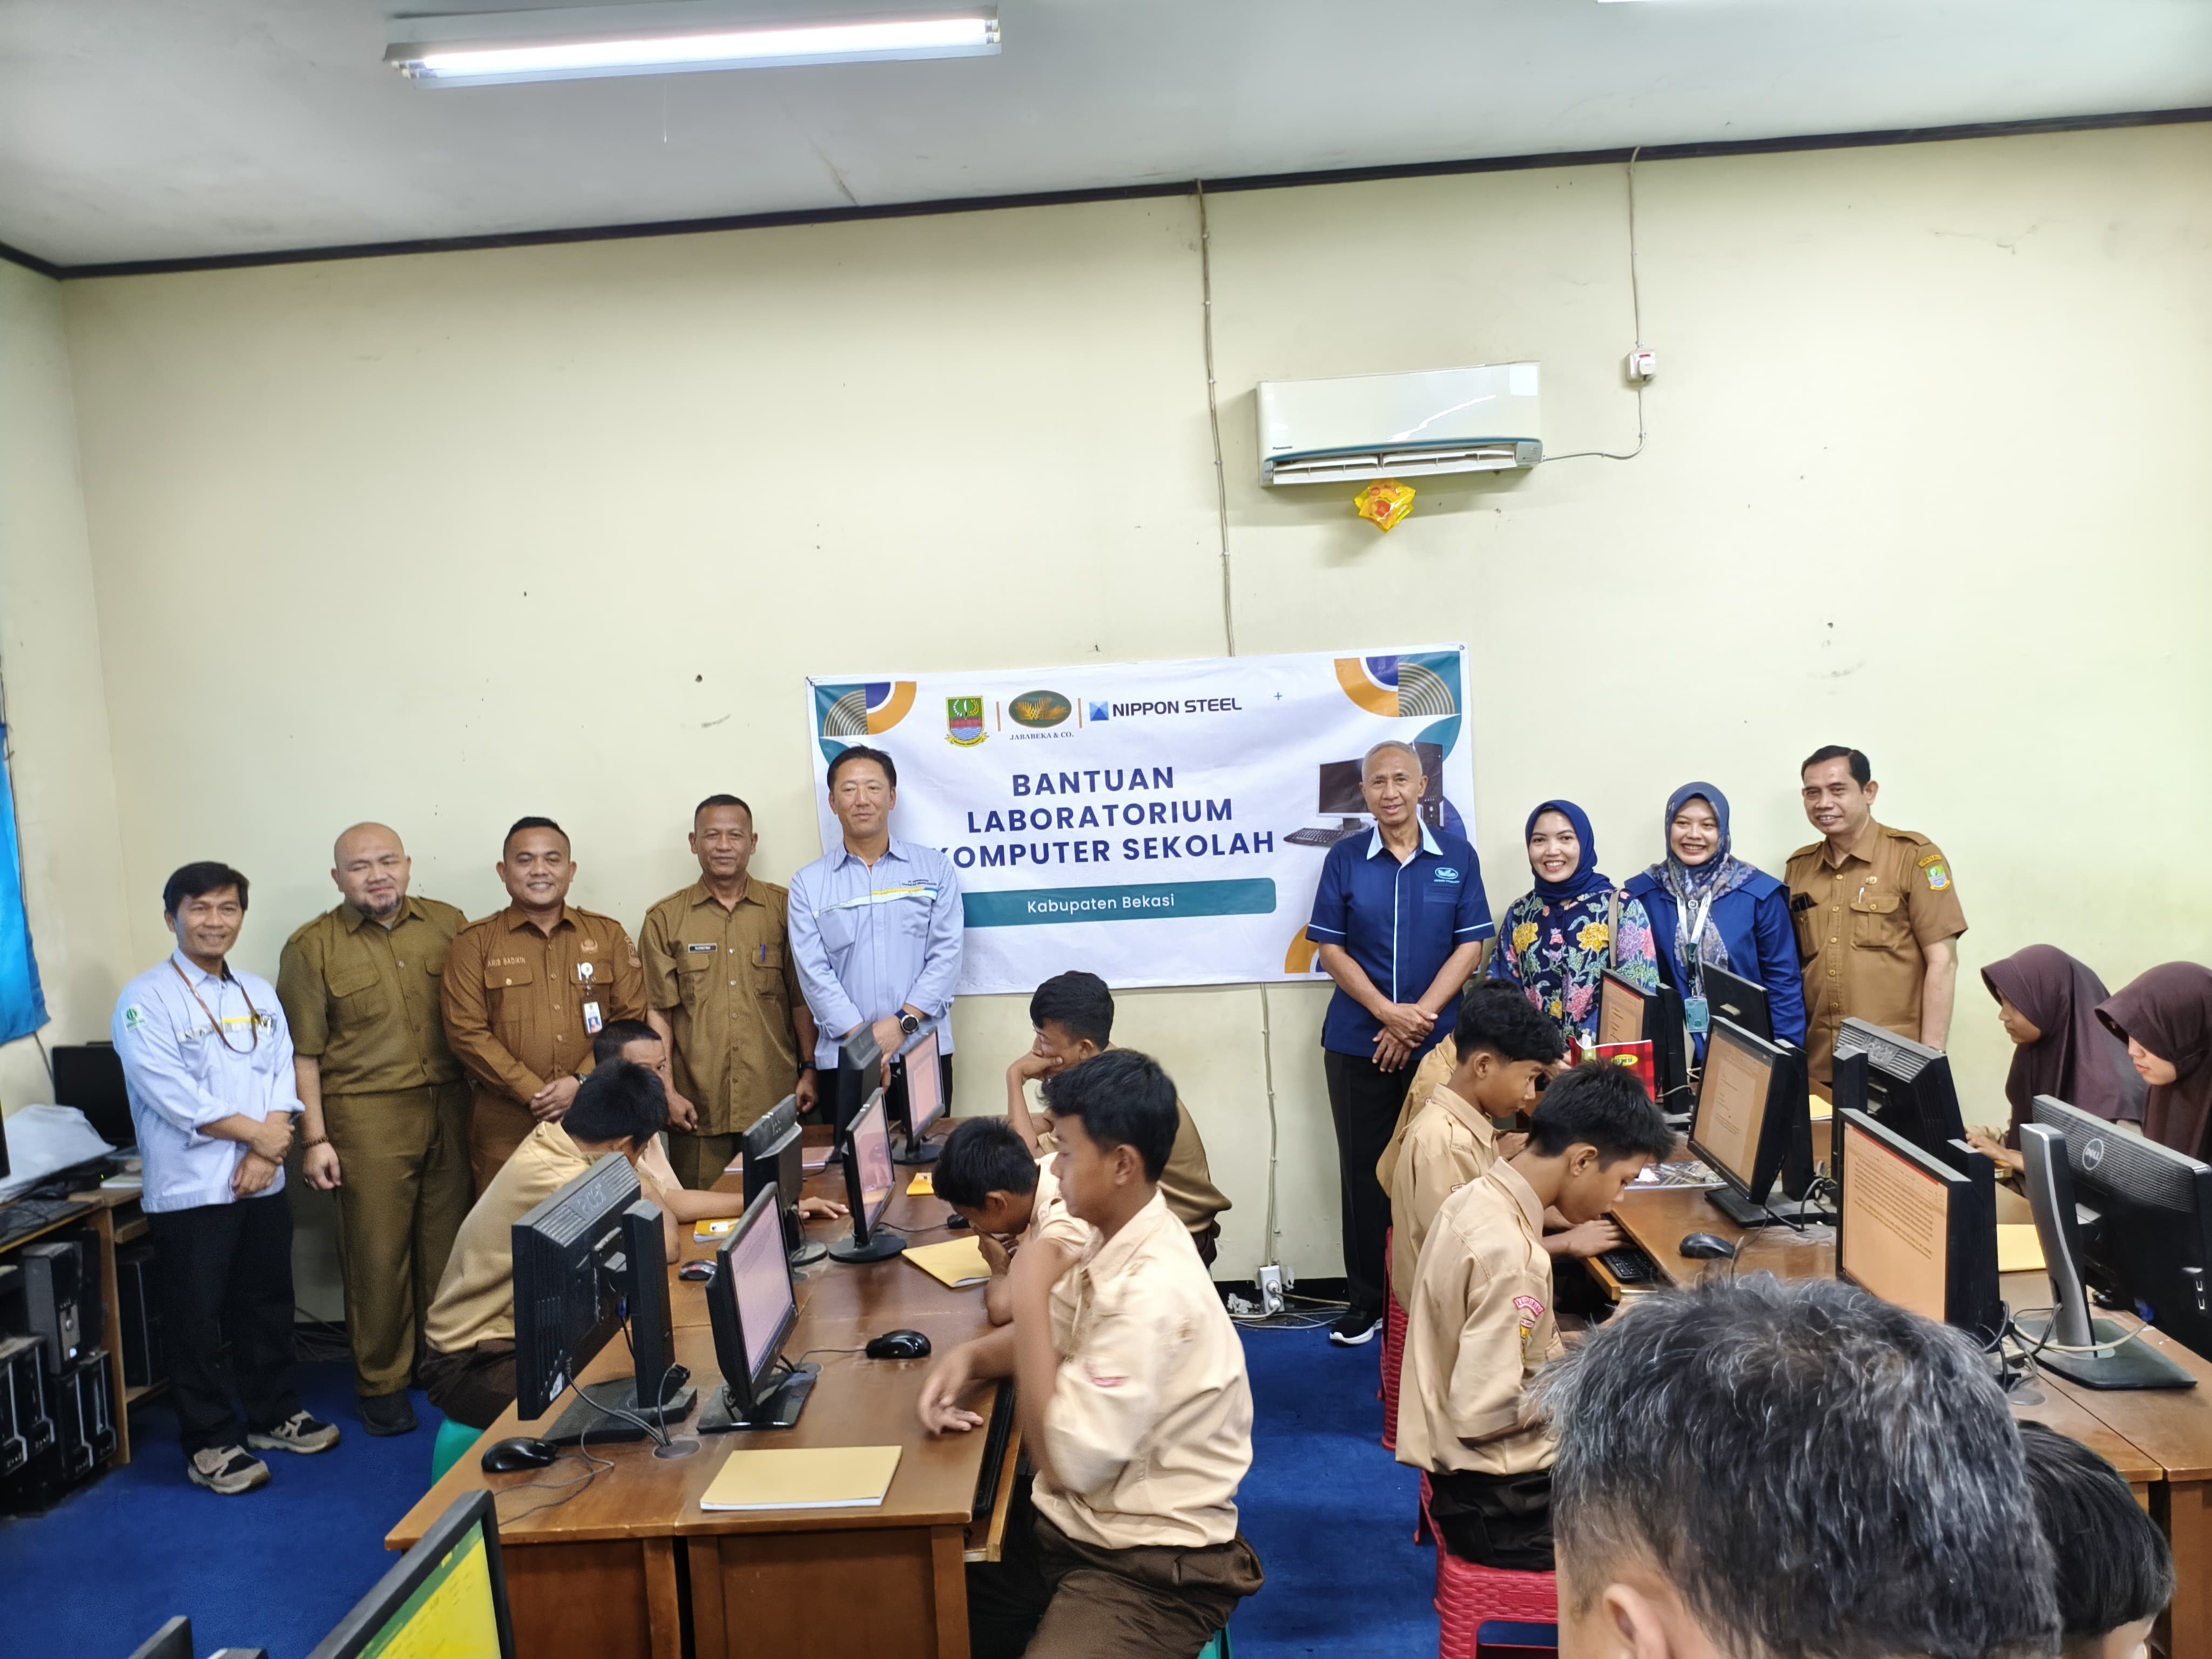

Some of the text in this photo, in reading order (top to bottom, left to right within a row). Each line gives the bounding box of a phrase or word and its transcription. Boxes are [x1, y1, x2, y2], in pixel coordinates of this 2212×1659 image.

[1112, 698, 1243, 717] NIPPON STEEL
[1012, 766, 1174, 797] BANTUAN
[967, 798, 1232, 833] LABORATORIUM
[932, 831, 1273, 868] OMPUTER SEKOLAH
[1028, 893, 1174, 915] Kabupaten Bekasi
